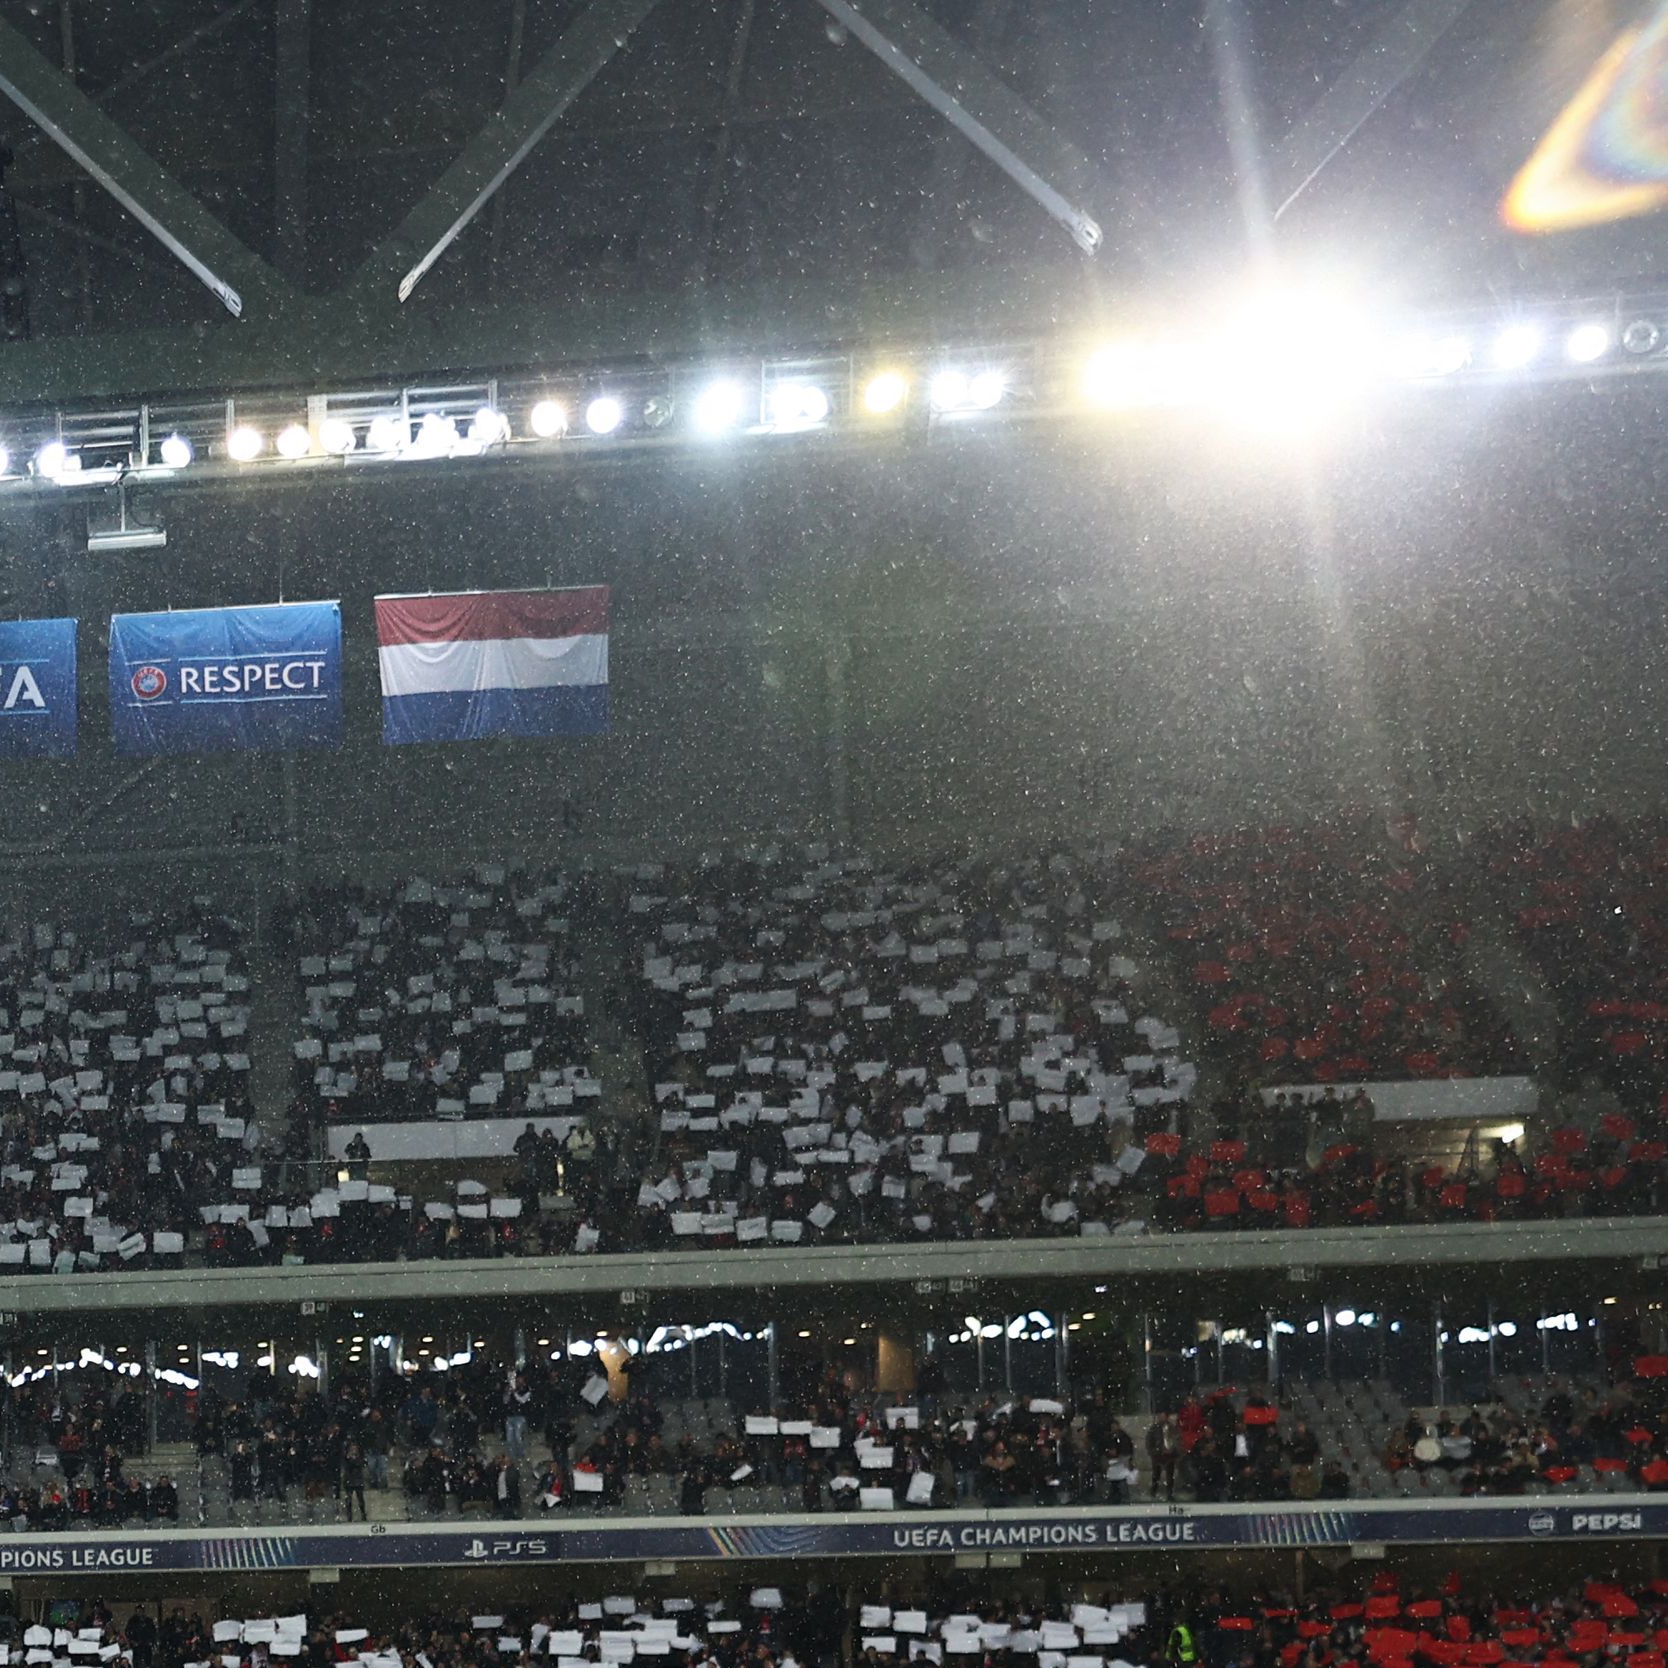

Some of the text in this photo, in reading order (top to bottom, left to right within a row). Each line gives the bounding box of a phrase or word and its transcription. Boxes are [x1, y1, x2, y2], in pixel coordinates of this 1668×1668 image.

[180, 660, 326, 694] RESPECT
[370, 1525, 386, 1533] Gb
[1572, 1513, 1641, 1530] PEPSI
[893, 1522, 1195, 1547] UEFA CHAMPIONS LEAGUE
[493, 1540, 546, 1555] PS5
[72, 1548, 153, 1566] LEAGUE
